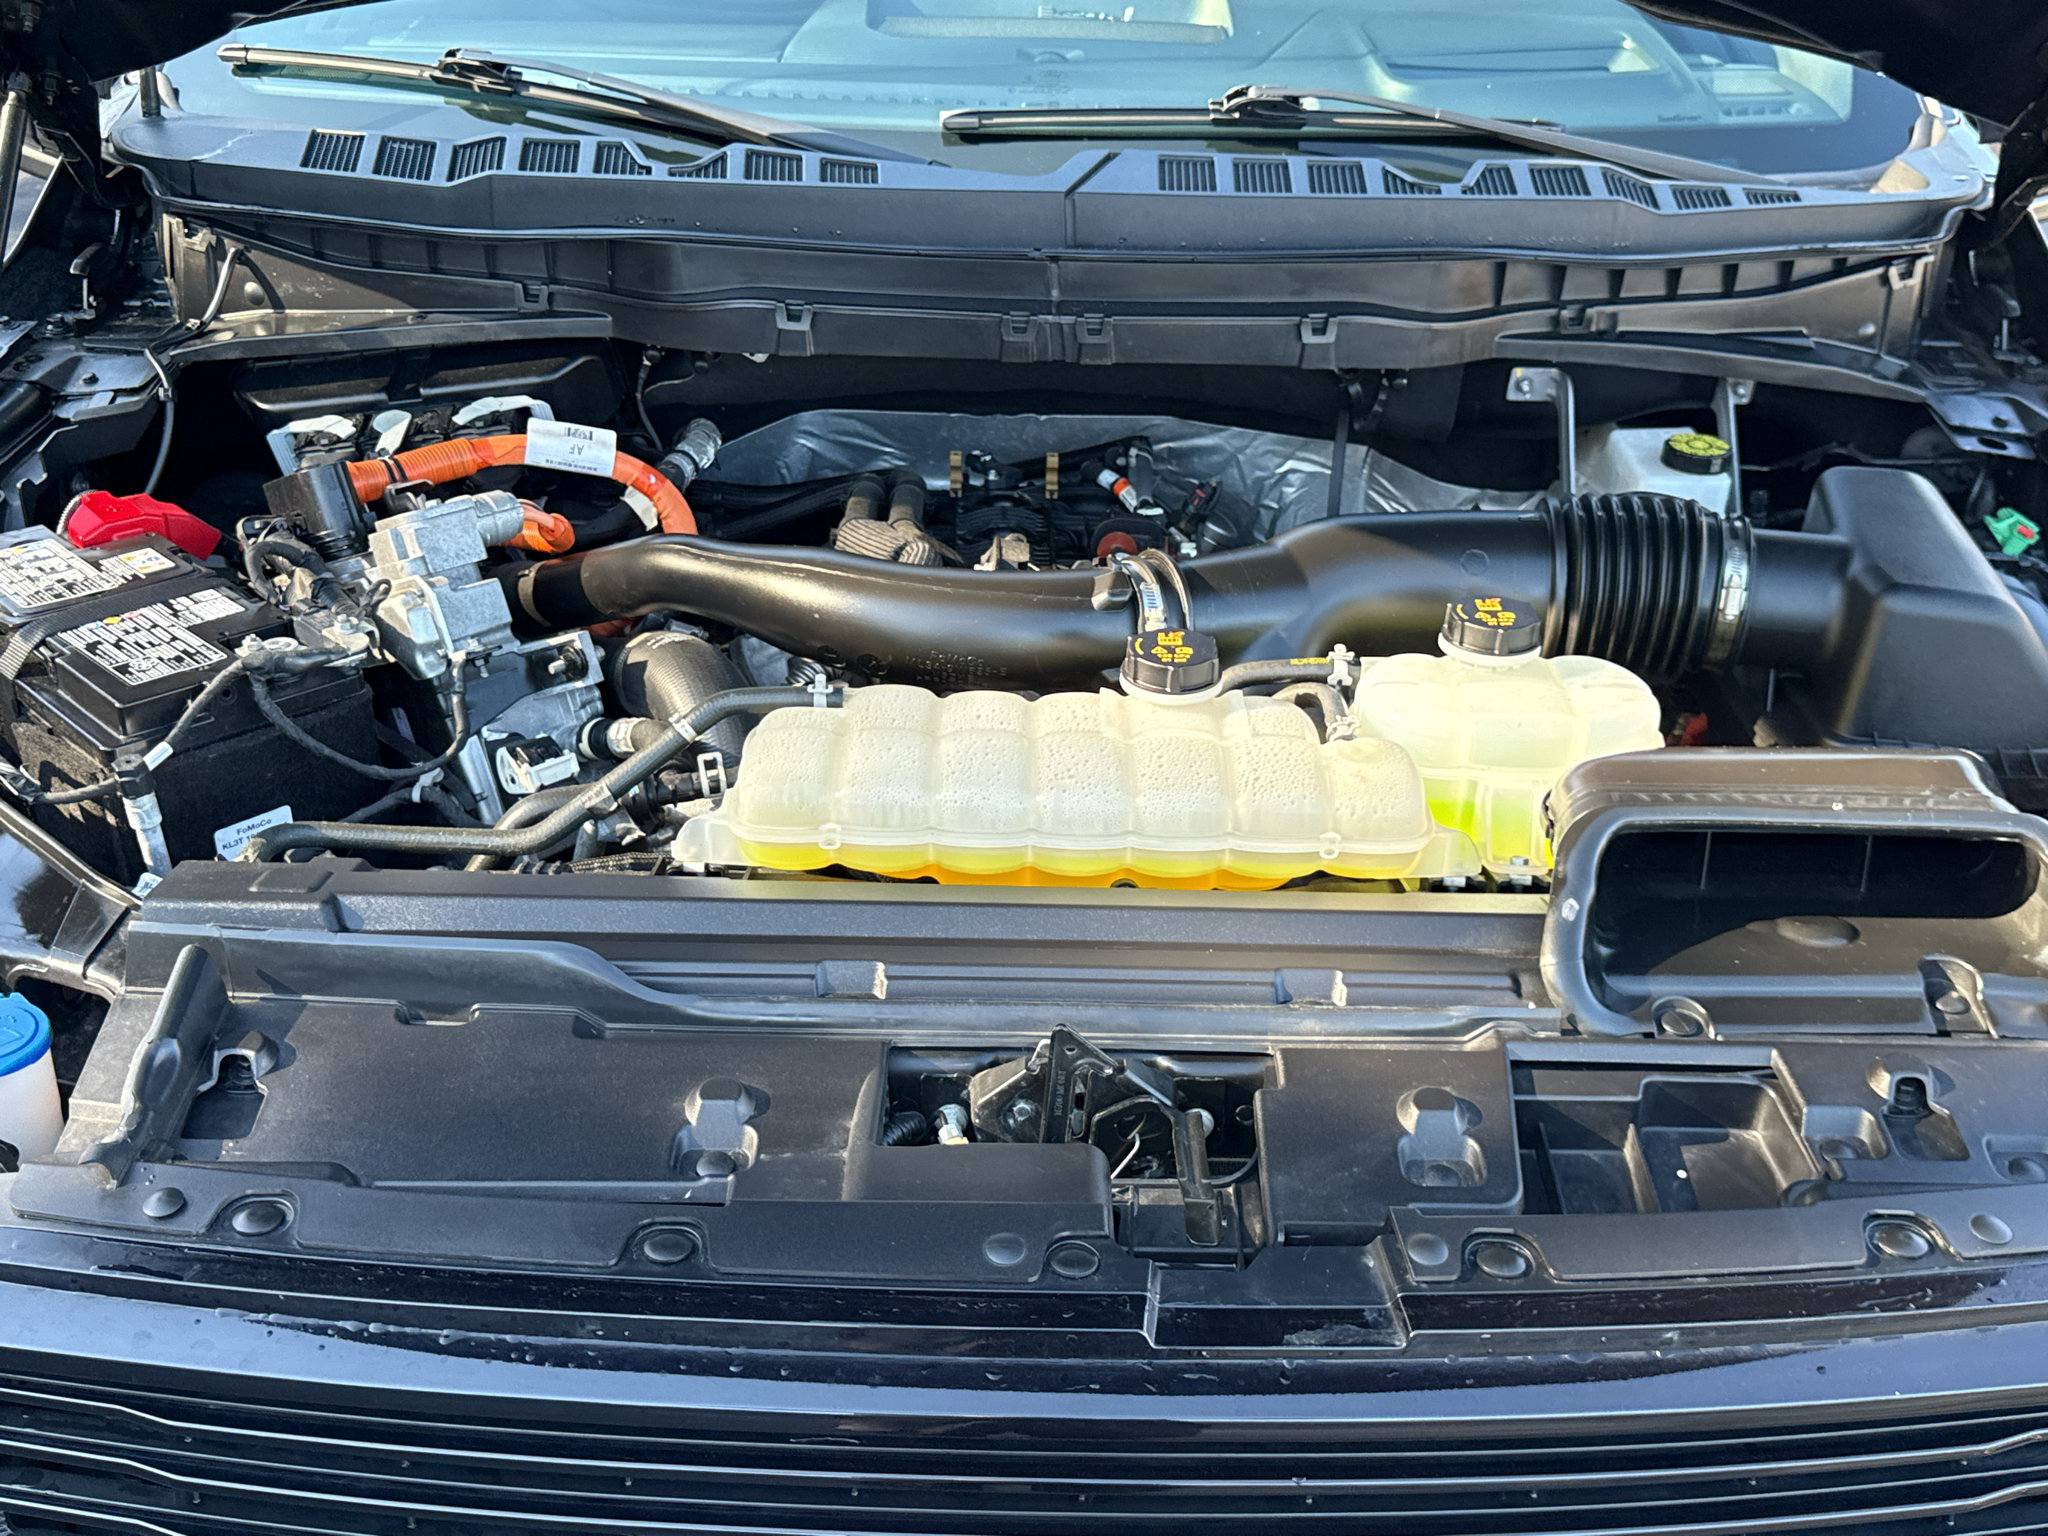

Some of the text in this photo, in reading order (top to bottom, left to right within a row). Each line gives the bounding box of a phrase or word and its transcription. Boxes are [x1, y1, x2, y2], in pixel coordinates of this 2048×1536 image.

[569, 443, 585, 455] AF
[237, 819, 272, 835] FoMoCo
[222, 838, 242, 850] KL3T
